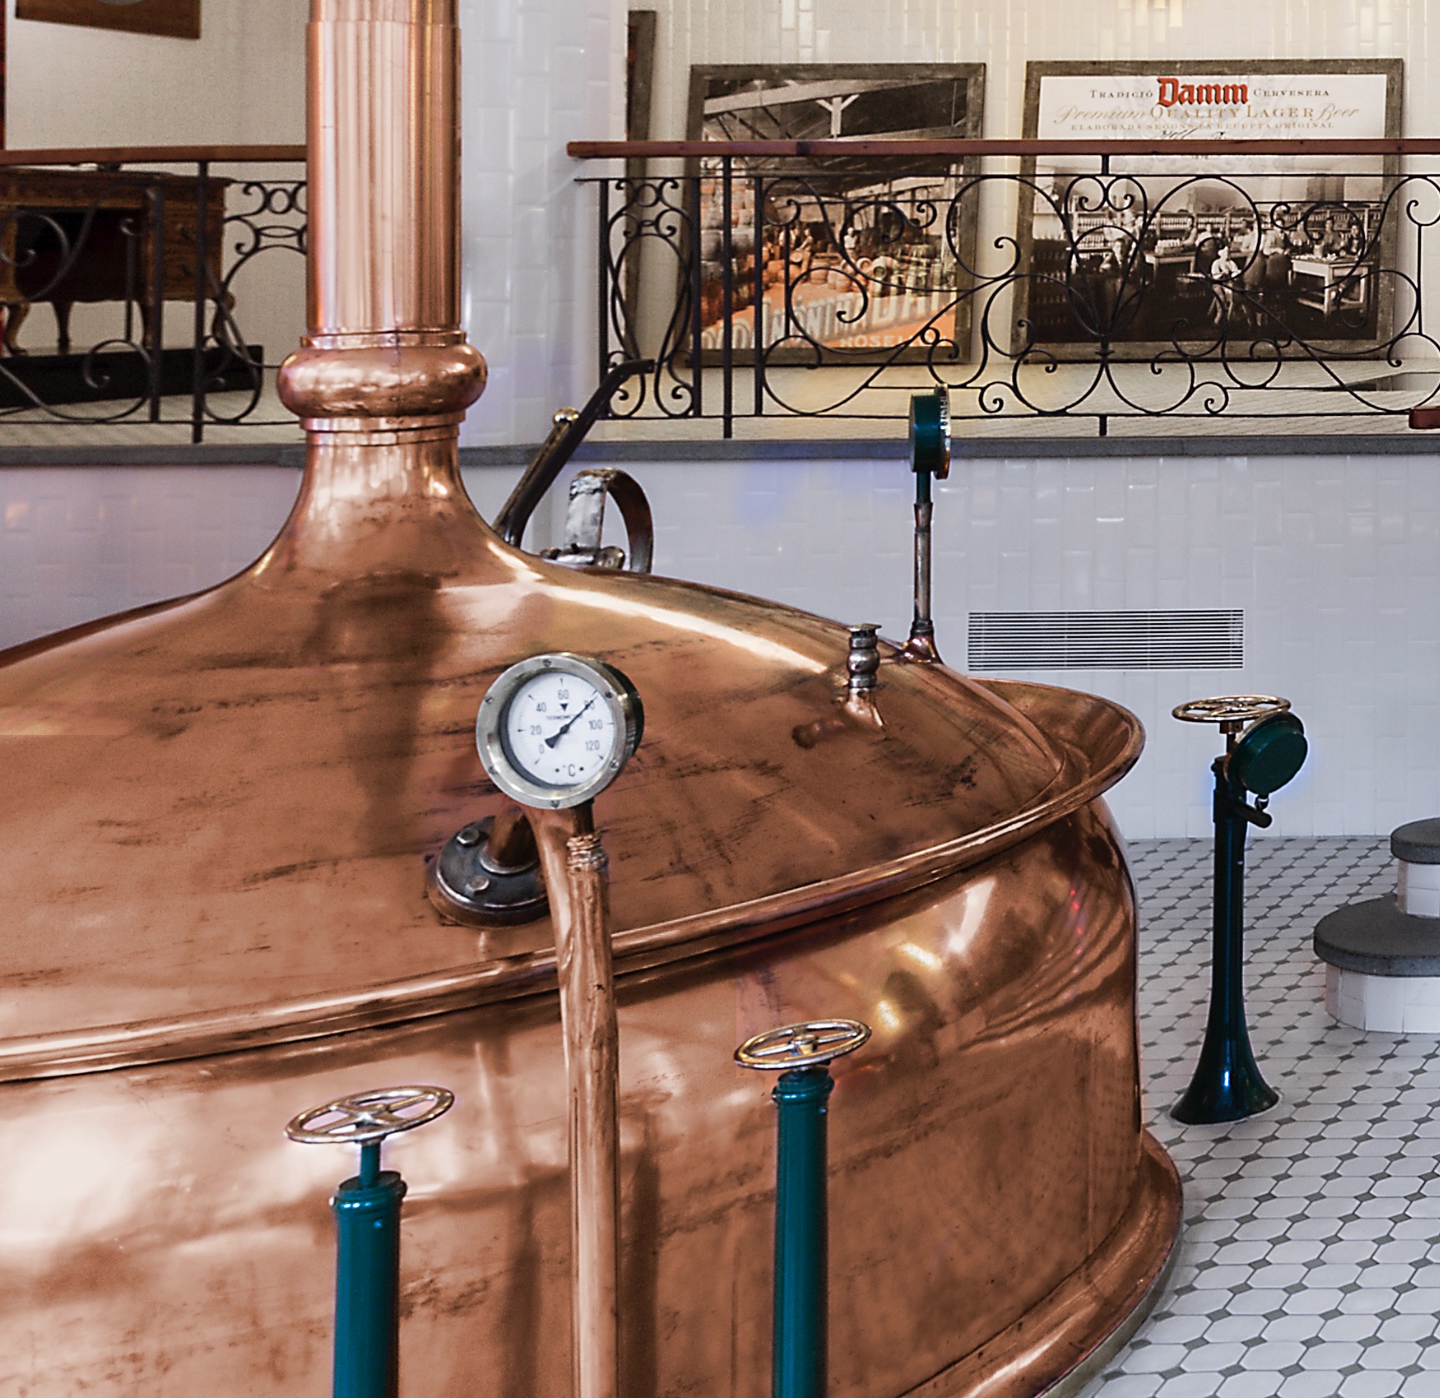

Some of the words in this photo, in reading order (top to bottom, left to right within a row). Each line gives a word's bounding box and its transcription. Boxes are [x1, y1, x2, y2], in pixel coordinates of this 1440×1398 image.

[1157, 77, 1249, 107] Damm
[1254, 88, 1330, 97] CERVESERA
[1053, 105, 1147, 123] Premium
[1150, 106, 1240, 121] QUALITY
[1247, 105, 1314, 118] LAGER
[1317, 103, 1359, 121] Beer
[557, 689, 569, 700] 60
[536, 702, 547, 712] 40
[530, 725, 542, 735] 20
[589, 719, 603, 730] 100
[539, 744, 545, 754] 0
[585, 740, 600, 751] 120
